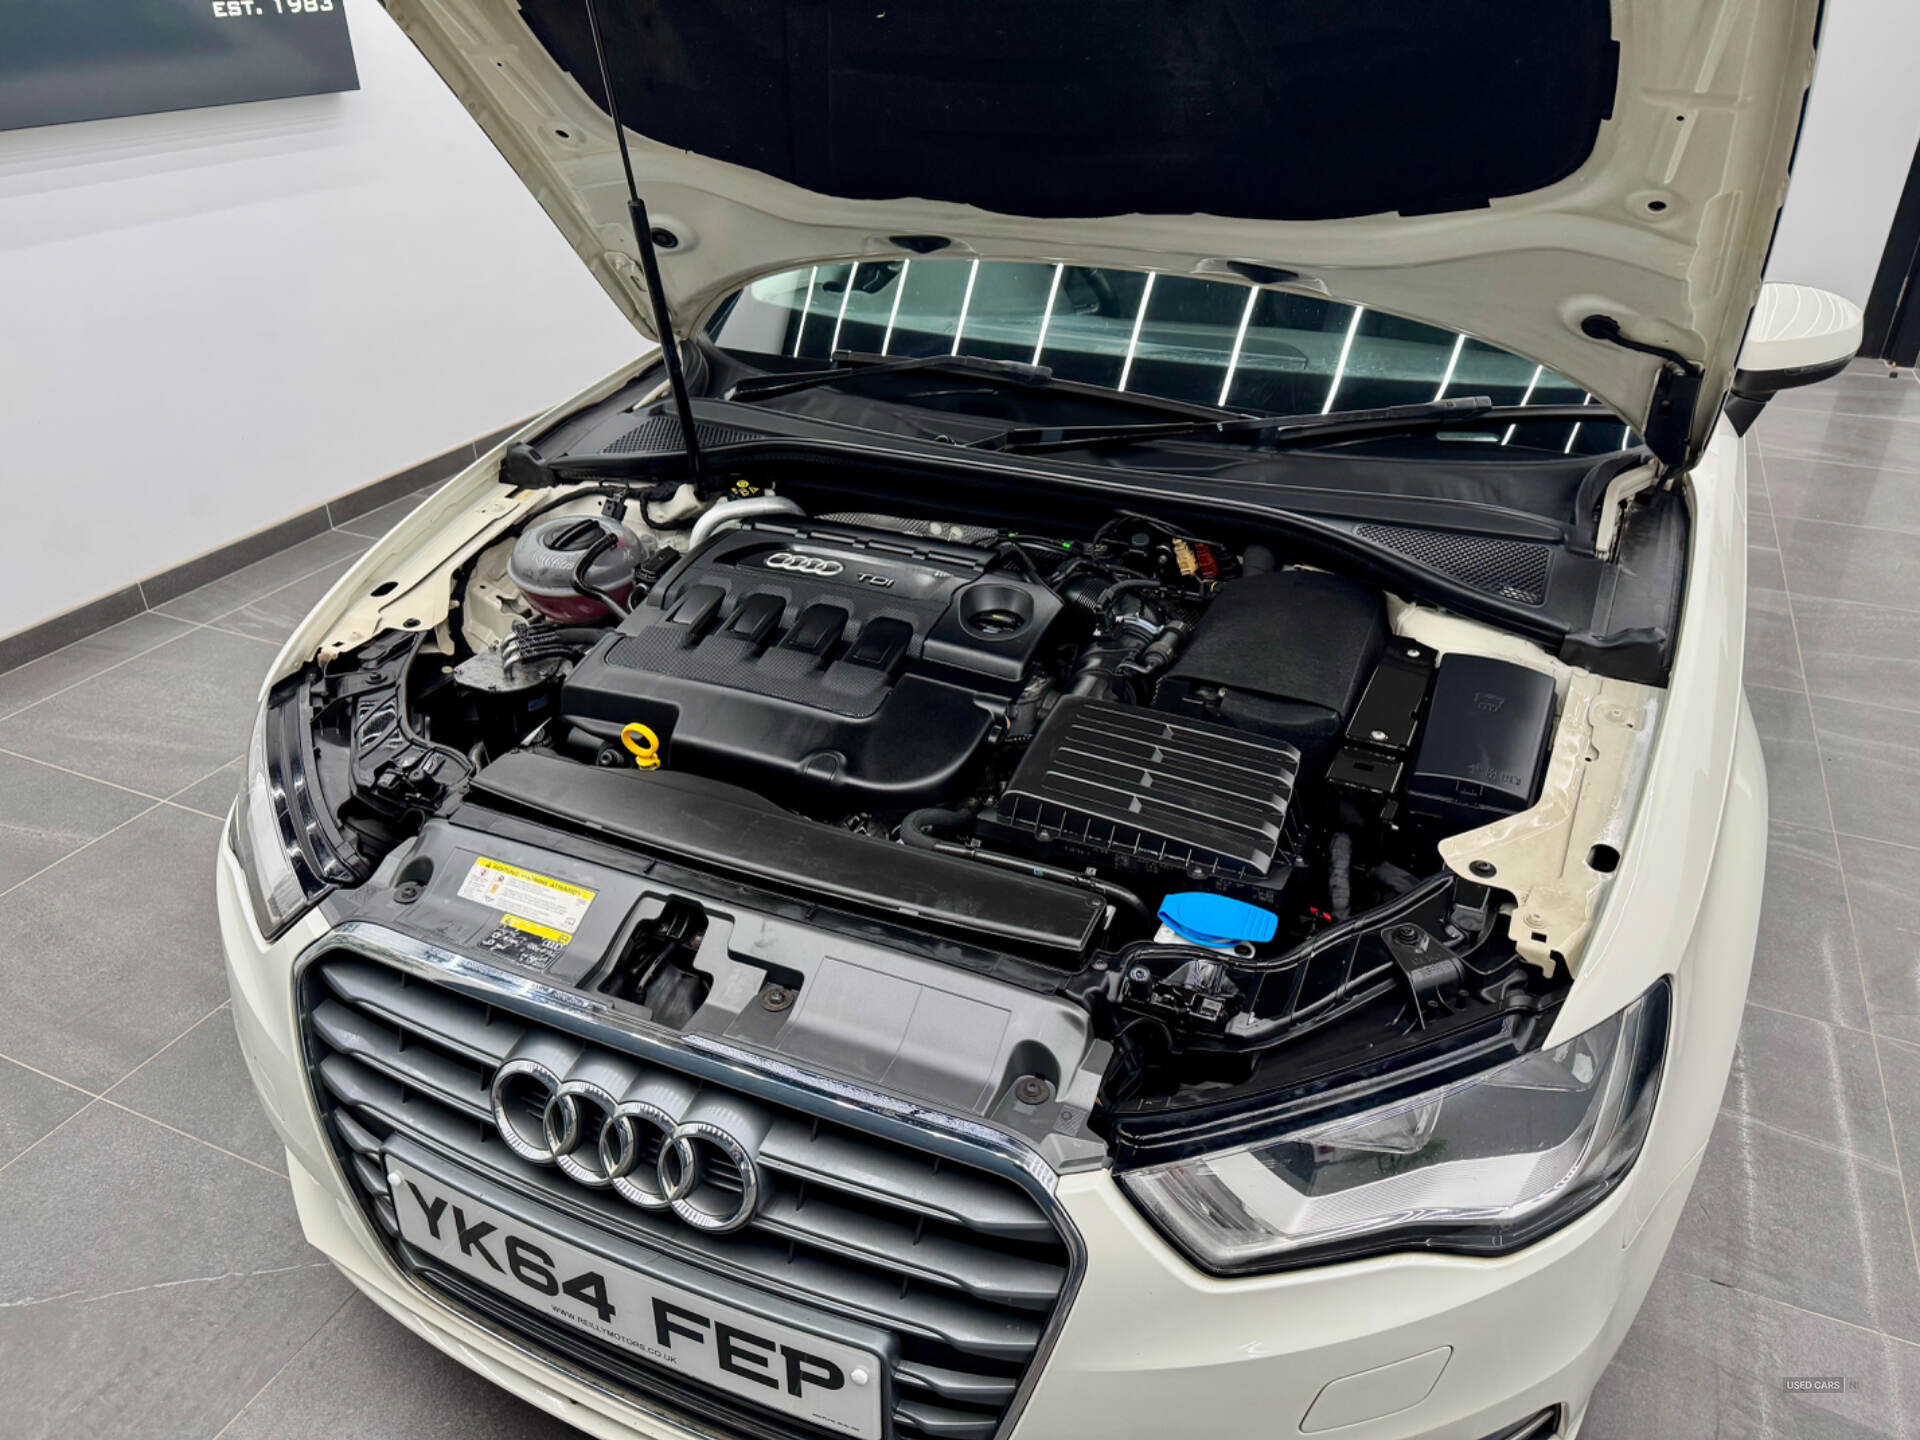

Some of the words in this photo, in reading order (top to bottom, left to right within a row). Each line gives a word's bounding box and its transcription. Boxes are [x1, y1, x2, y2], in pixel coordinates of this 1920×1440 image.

[212, 0, 263, 17] EST.
[273, 0, 334, 13] 1983
[858, 572, 895, 588] TDI
[406, 1180, 616, 1323] YK64
[651, 1296, 845, 1398] FEP
